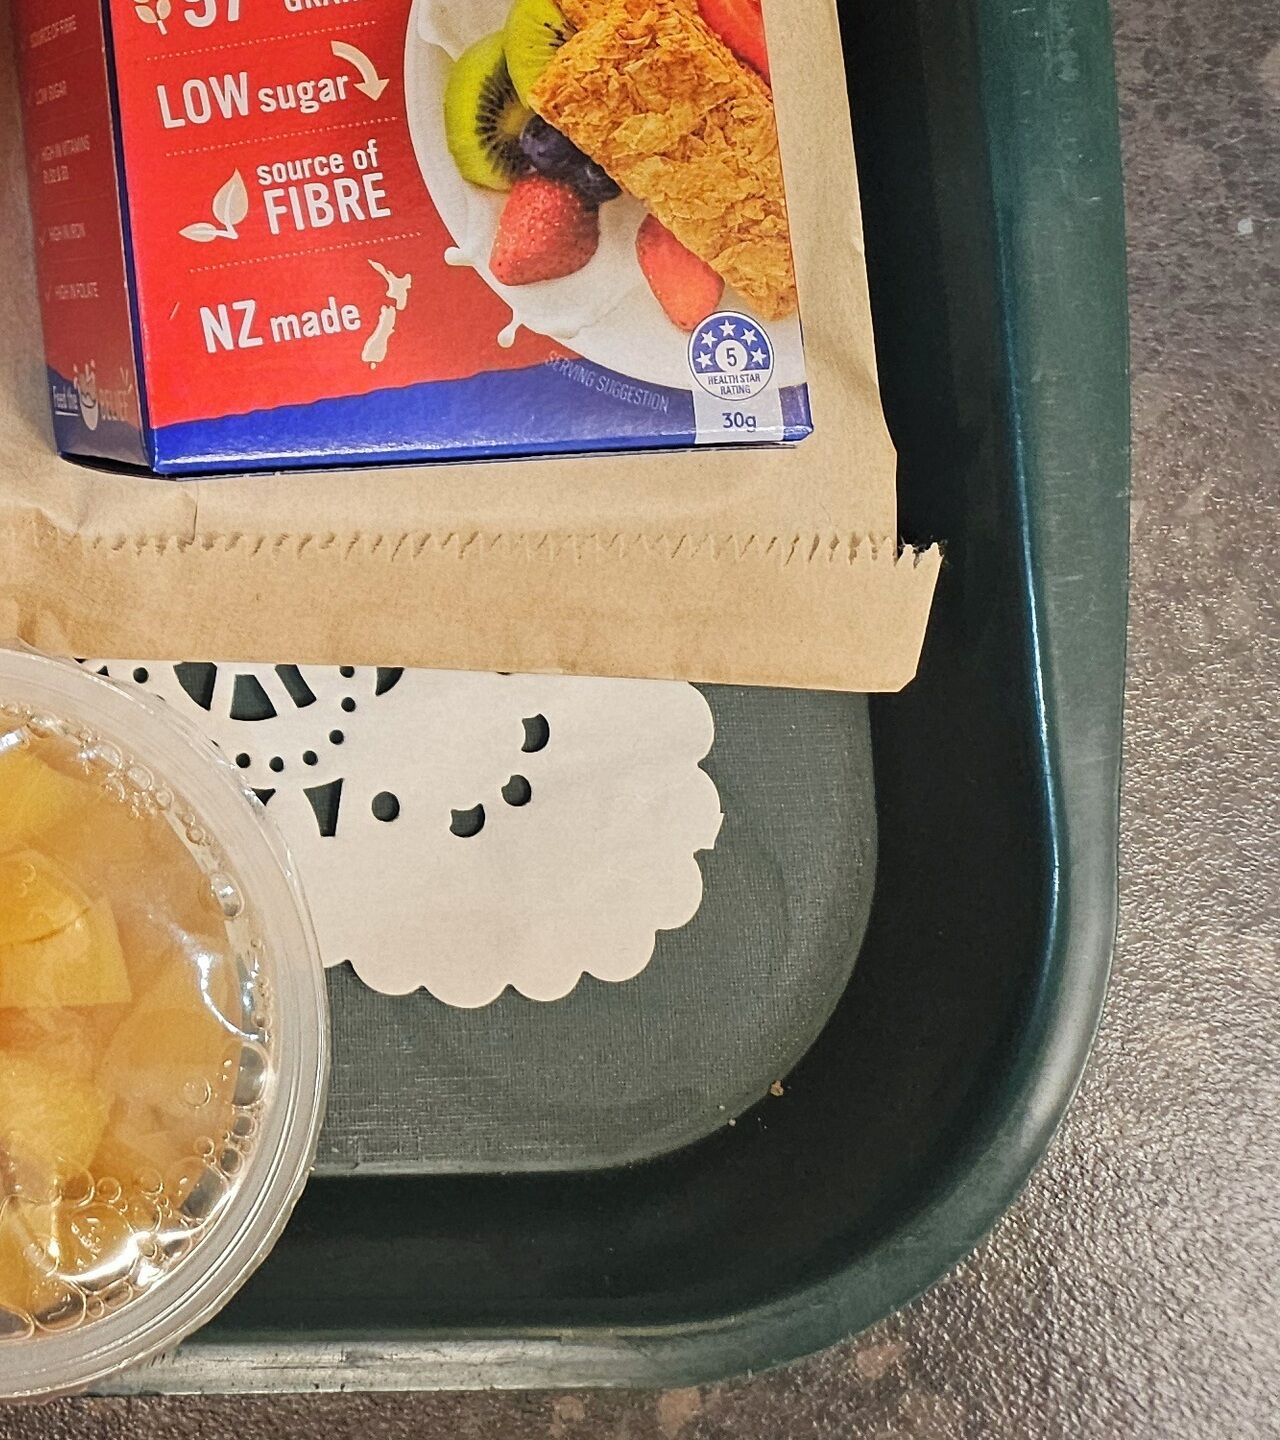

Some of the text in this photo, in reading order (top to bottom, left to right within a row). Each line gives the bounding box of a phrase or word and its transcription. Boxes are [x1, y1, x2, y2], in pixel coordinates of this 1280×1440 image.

[157, 71, 349, 128] LOW sugar
[256, 138, 379, 186] source of
[263, 172, 391, 235] FIBRE
[199, 295, 362, 354] NZ made
[708, 373, 761, 386] HEALTH STAR
[726, 347, 738, 367] 5
[544, 349, 670, 415] SERVING SUGGESTION
[720, 384, 751, 396] RATING
[722, 411, 757, 433] 30g
